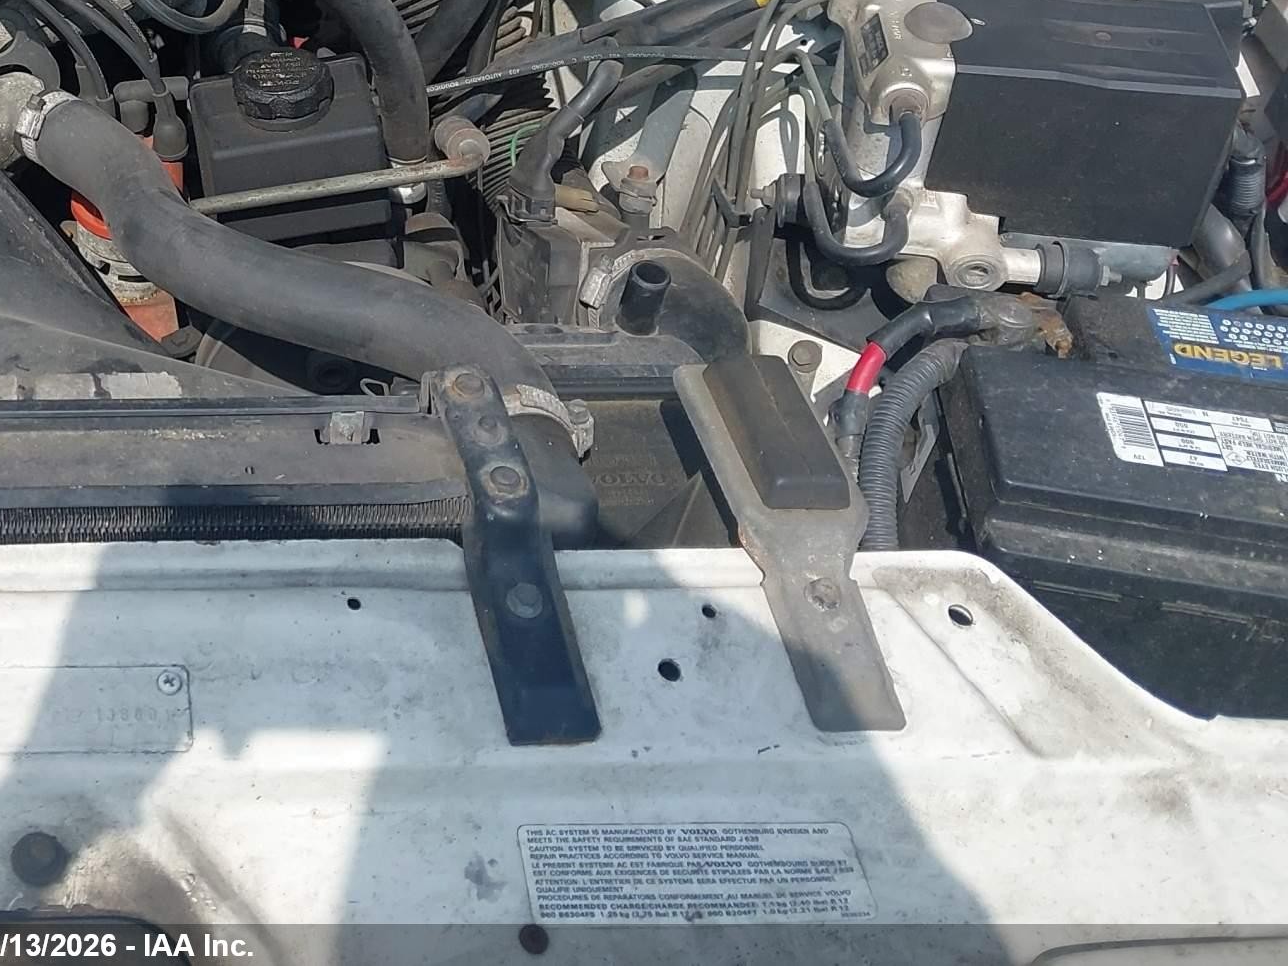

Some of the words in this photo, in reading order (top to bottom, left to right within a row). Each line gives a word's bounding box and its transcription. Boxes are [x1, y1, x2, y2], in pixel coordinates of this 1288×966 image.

[1174, 342, 1284, 370] LEGEND
[720, 844, 764, 852] PERSONNEL
[603, 852, 650, 860] ACCORDING
[630, 861, 644, 869] EST
[704, 860, 742, 868] VOLVO
[539, 902, 608, 911] RECOMMENDED
